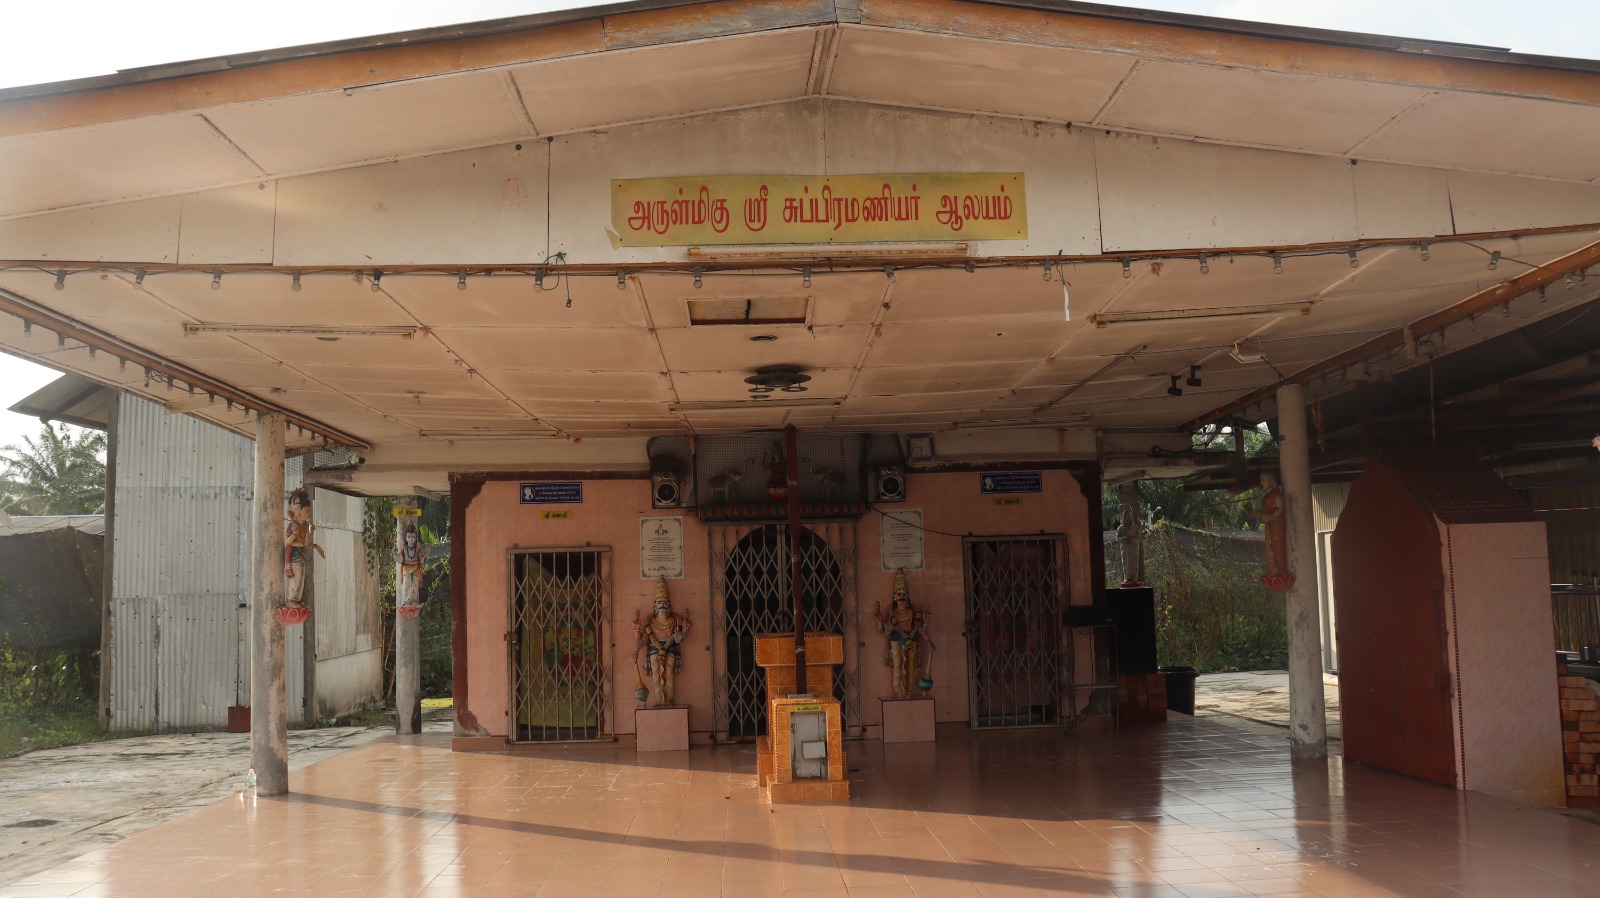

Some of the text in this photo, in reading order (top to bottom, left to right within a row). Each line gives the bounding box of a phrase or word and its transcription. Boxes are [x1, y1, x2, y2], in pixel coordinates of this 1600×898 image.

[628, 185, 730, 234] அருள்மிகு
[783, 183, 921, 231] சுப்பிரமணியர்
[936, 184, 1013, 231] ஆலயம்
